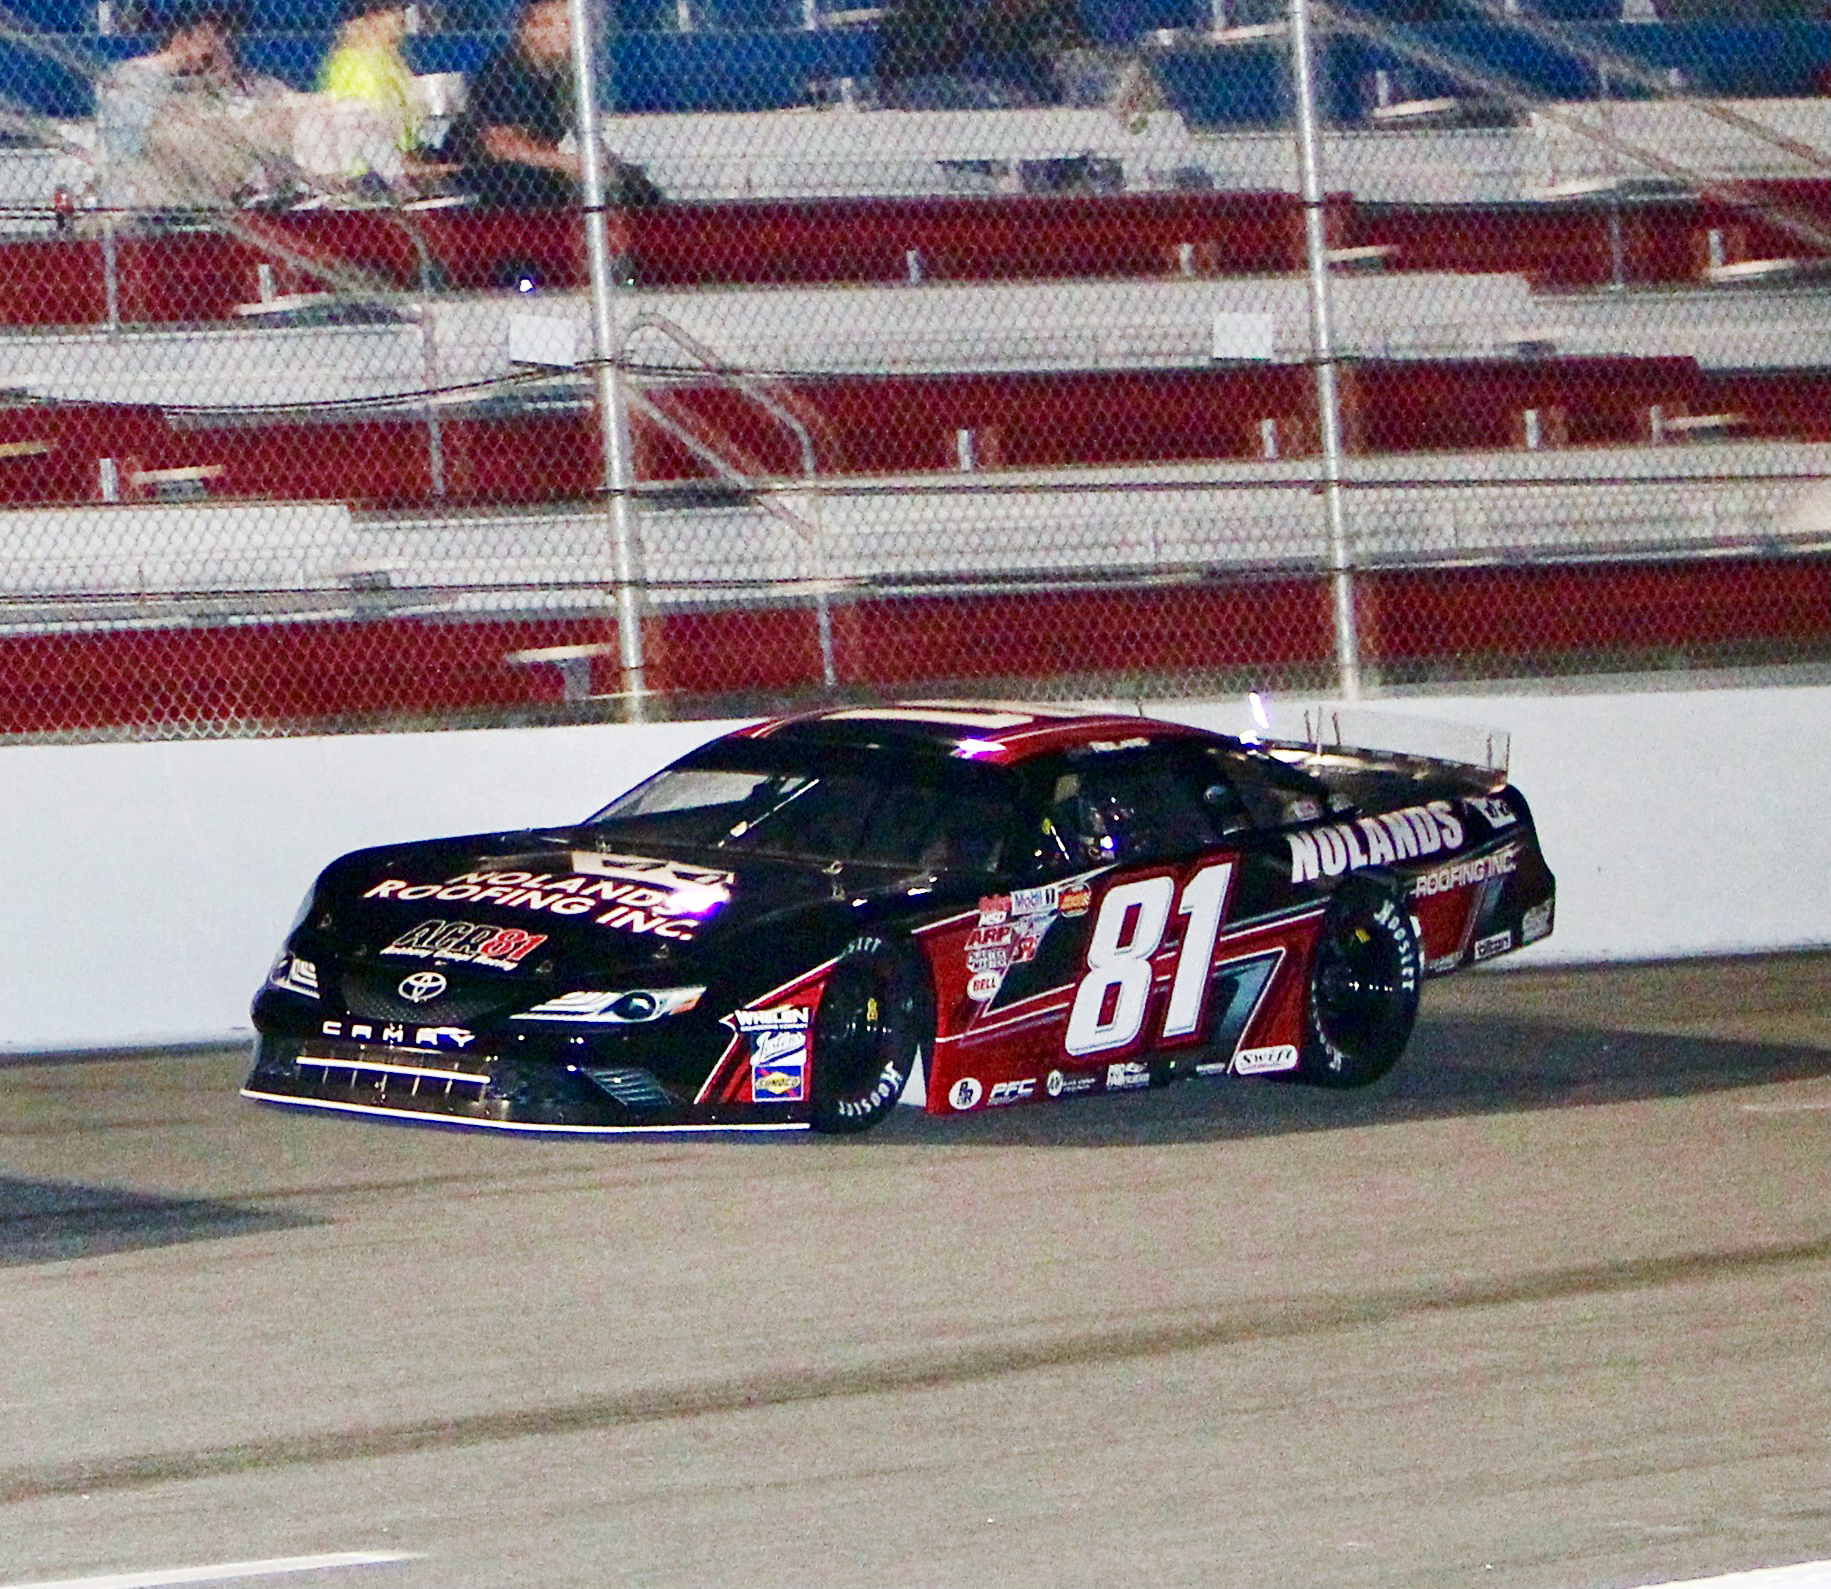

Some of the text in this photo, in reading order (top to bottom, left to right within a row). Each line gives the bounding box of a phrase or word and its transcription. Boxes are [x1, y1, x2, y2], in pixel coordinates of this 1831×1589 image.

[1286, 800, 1463, 883] NOLANDS
[1416, 858, 1485, 897] ROOFING
[362, 879, 699, 941] ROOFING INC.
[1064, 862, 1233, 1056] 81
[322, 1021, 476, 1048] CAMRY
[838, 1060, 904, 1117] Hoosier
